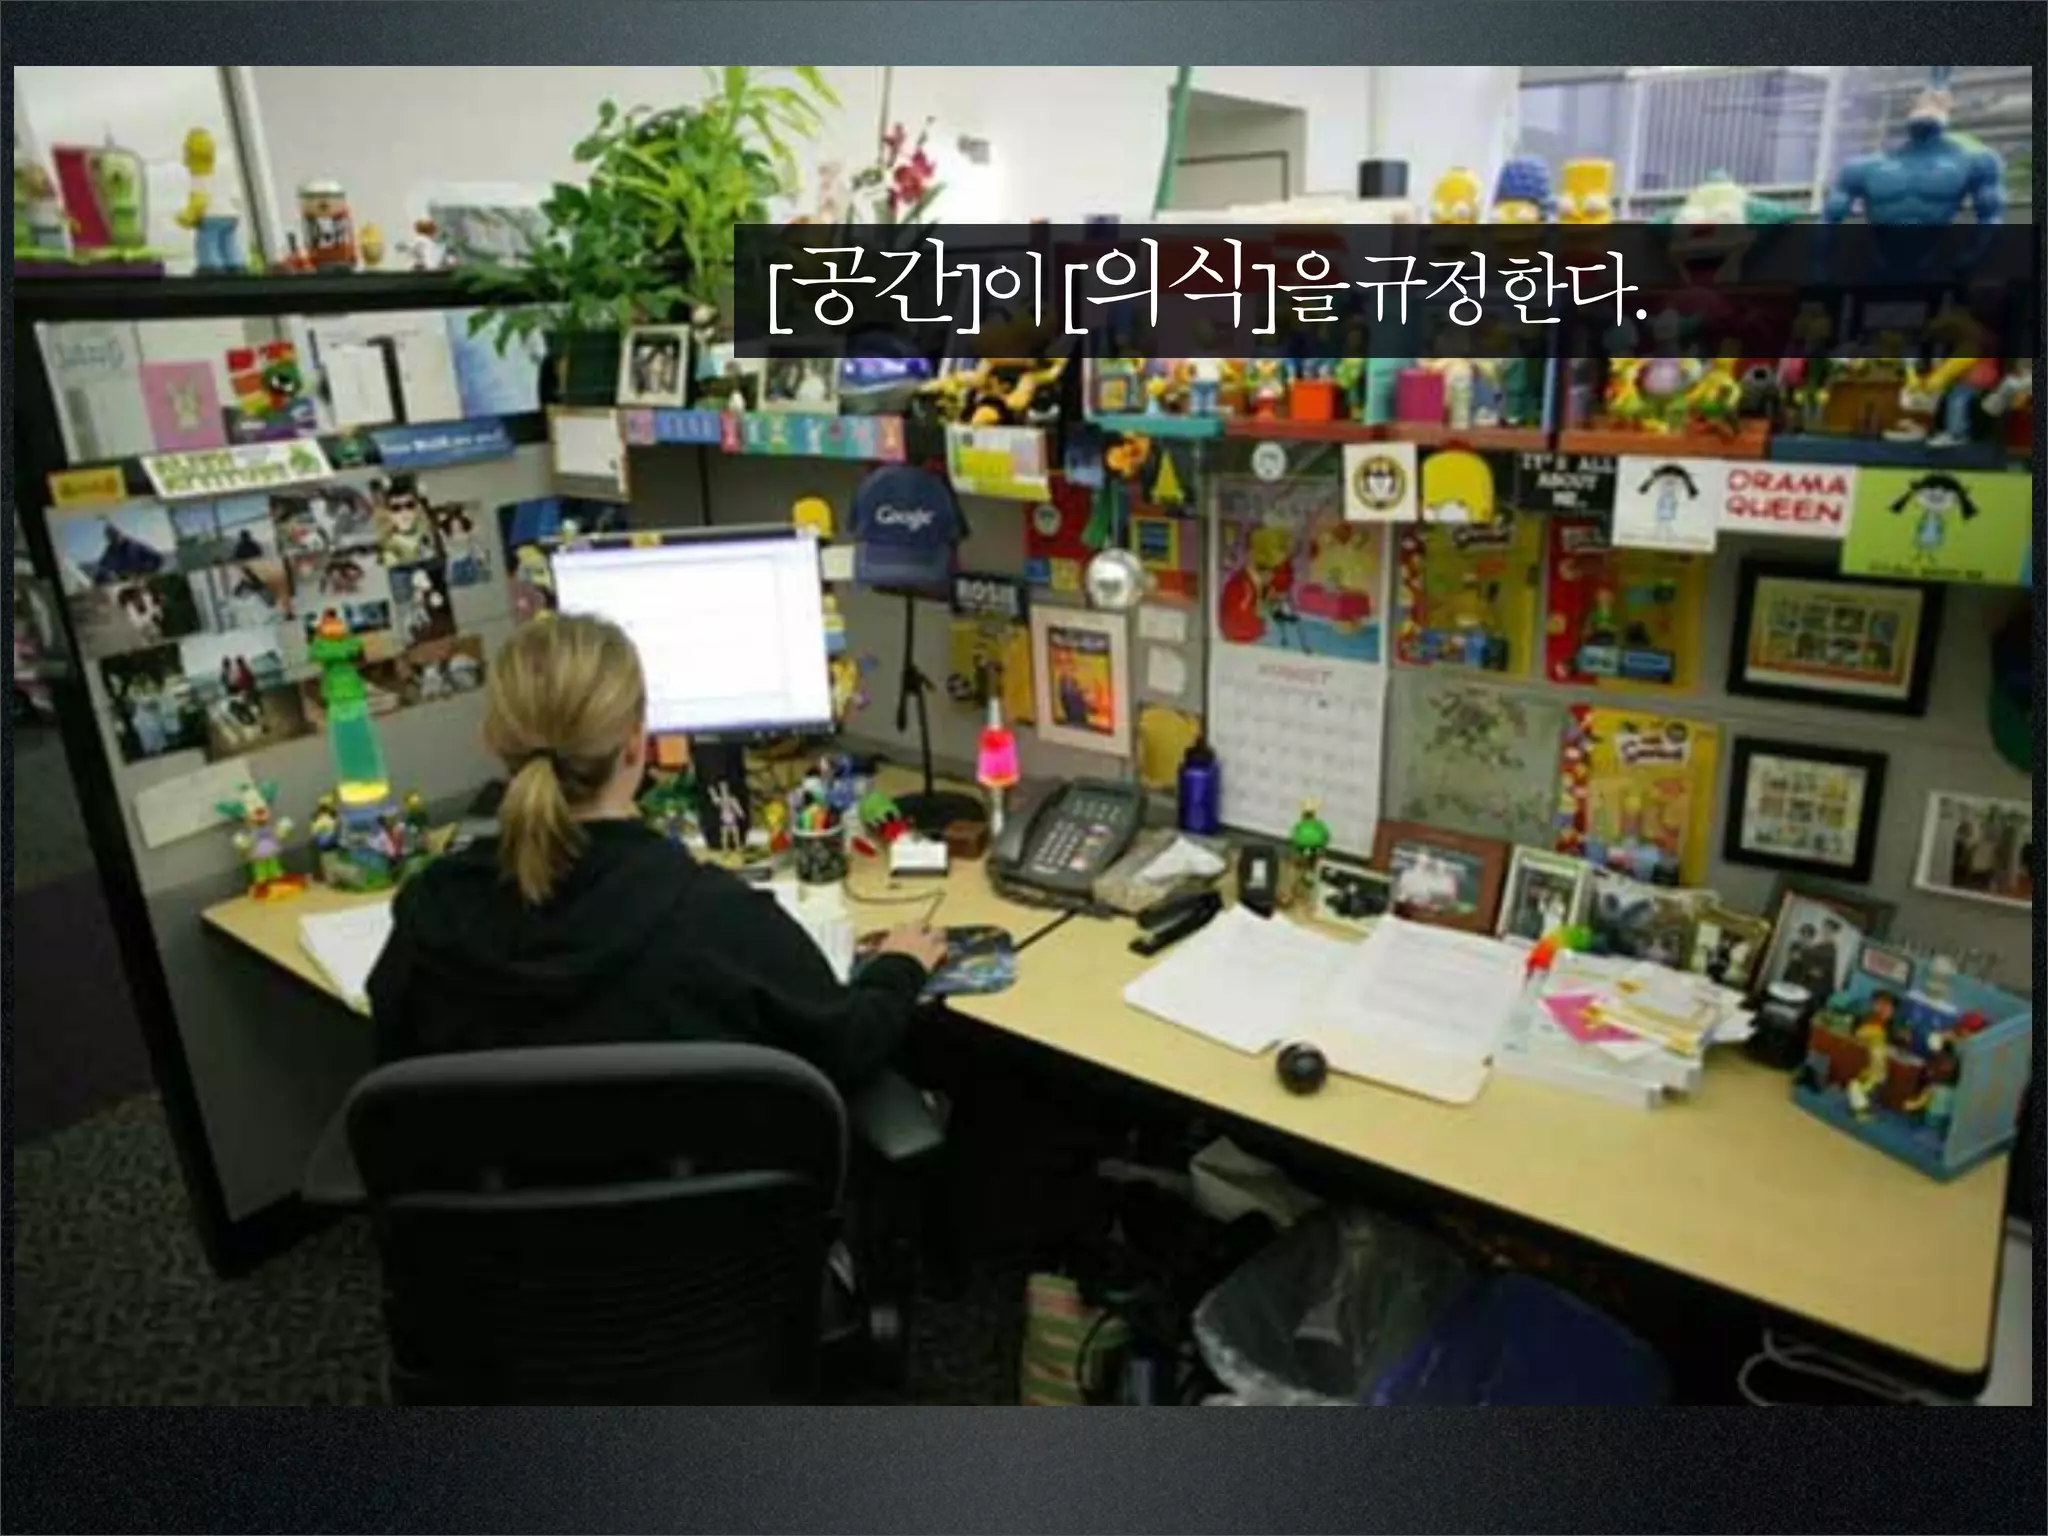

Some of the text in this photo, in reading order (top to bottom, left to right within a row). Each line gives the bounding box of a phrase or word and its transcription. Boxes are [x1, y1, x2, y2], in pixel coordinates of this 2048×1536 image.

[1728, 469, 1847, 496] DRAMA
[874, 503, 937, 532] Google
[1725, 495, 1843, 522] QUEEN
